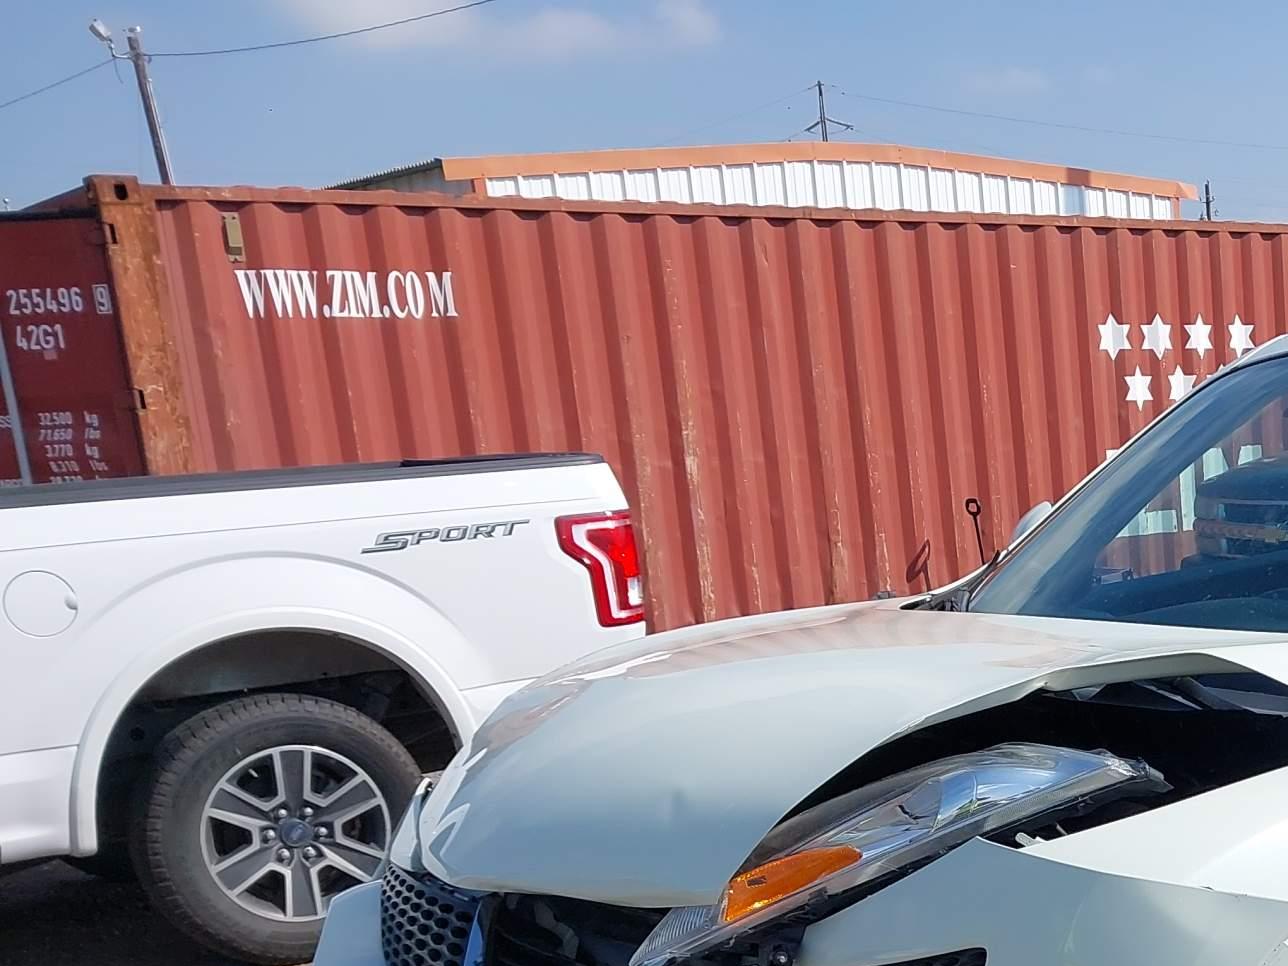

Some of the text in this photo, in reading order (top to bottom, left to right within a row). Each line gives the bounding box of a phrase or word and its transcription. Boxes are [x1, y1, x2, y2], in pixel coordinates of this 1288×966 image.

[6, 285, 110, 315] 255496 9
[234, 269, 459, 319] WWW.ZIM.COM
[16, 323, 65, 350] 42G1
[360, 519, 530, 554] SPORT
